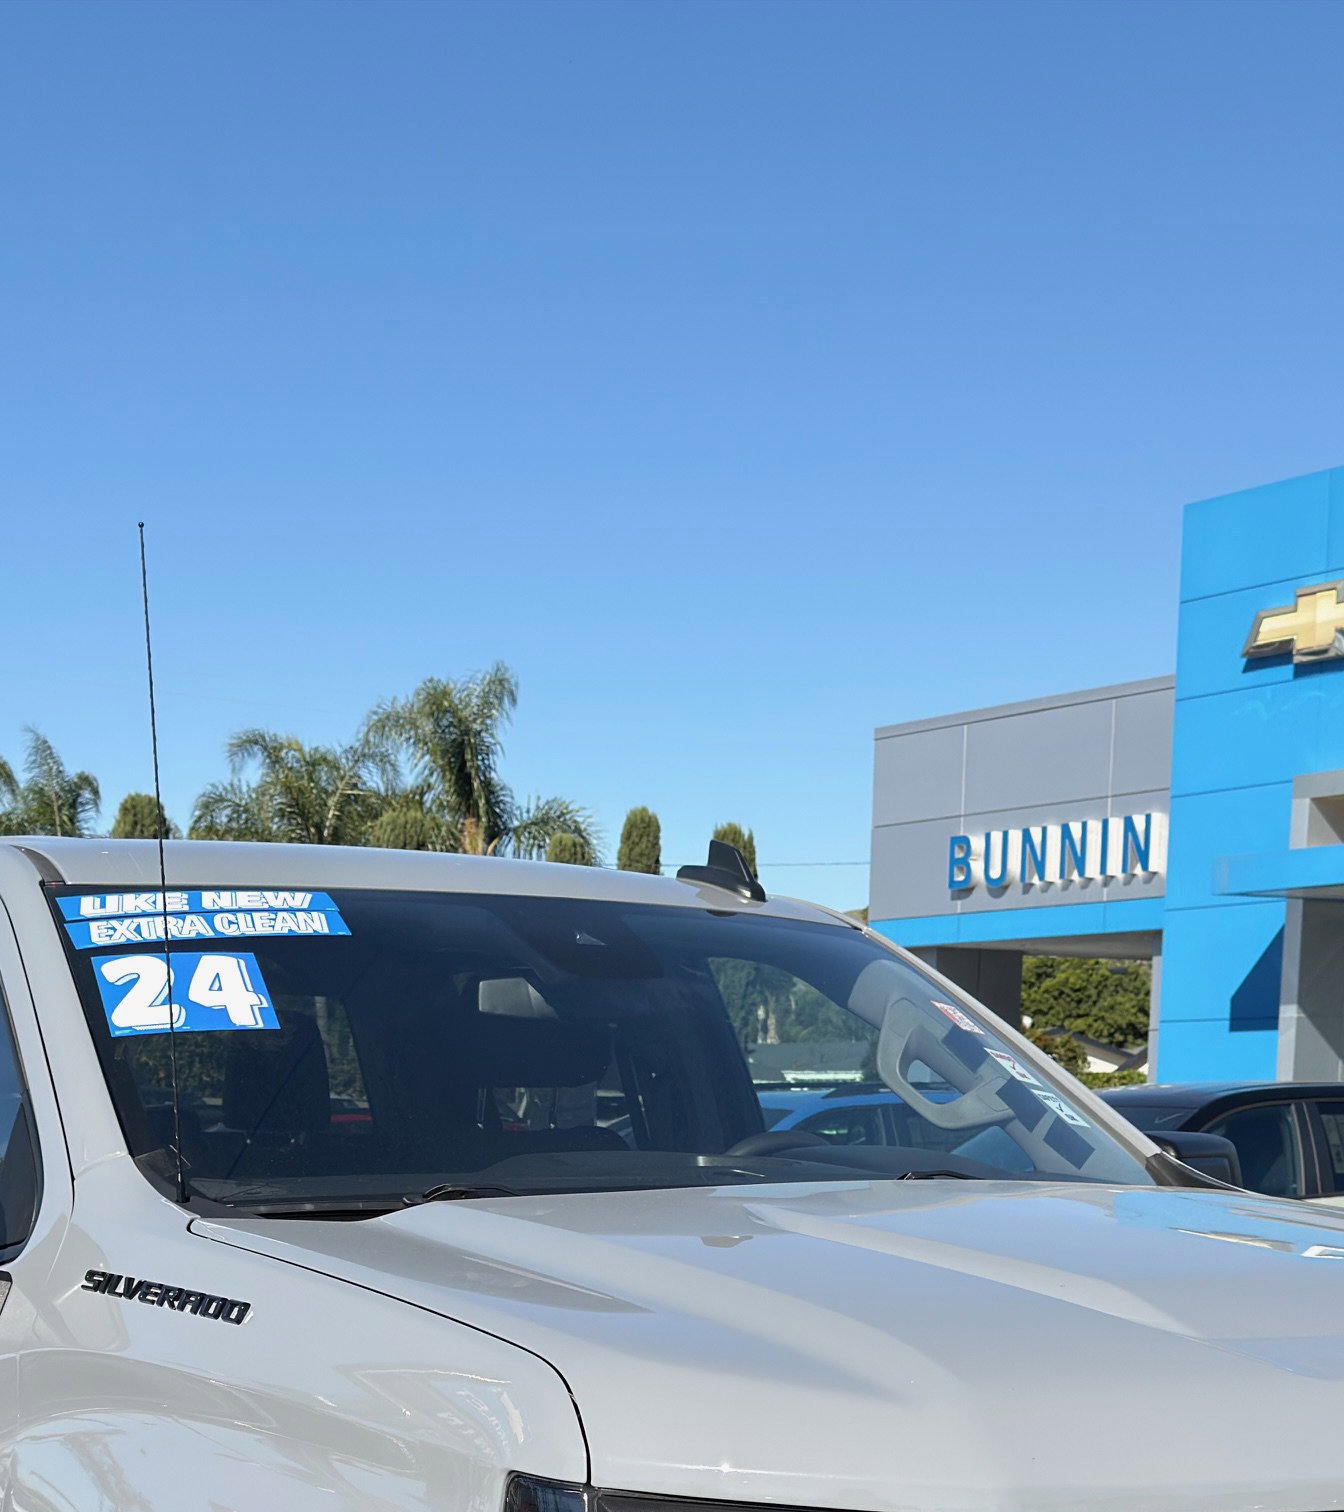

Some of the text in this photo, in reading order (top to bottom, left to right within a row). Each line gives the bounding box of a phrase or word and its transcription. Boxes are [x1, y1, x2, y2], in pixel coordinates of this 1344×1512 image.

[948, 812, 1165, 890] BUNNIN
[79, 891, 313, 917] LIKE NEW
[89, 910, 330, 945] EXTRA CLEAN
[100, 954, 268, 1030] 24
[81, 1269, 252, 1325] SILVERADO
